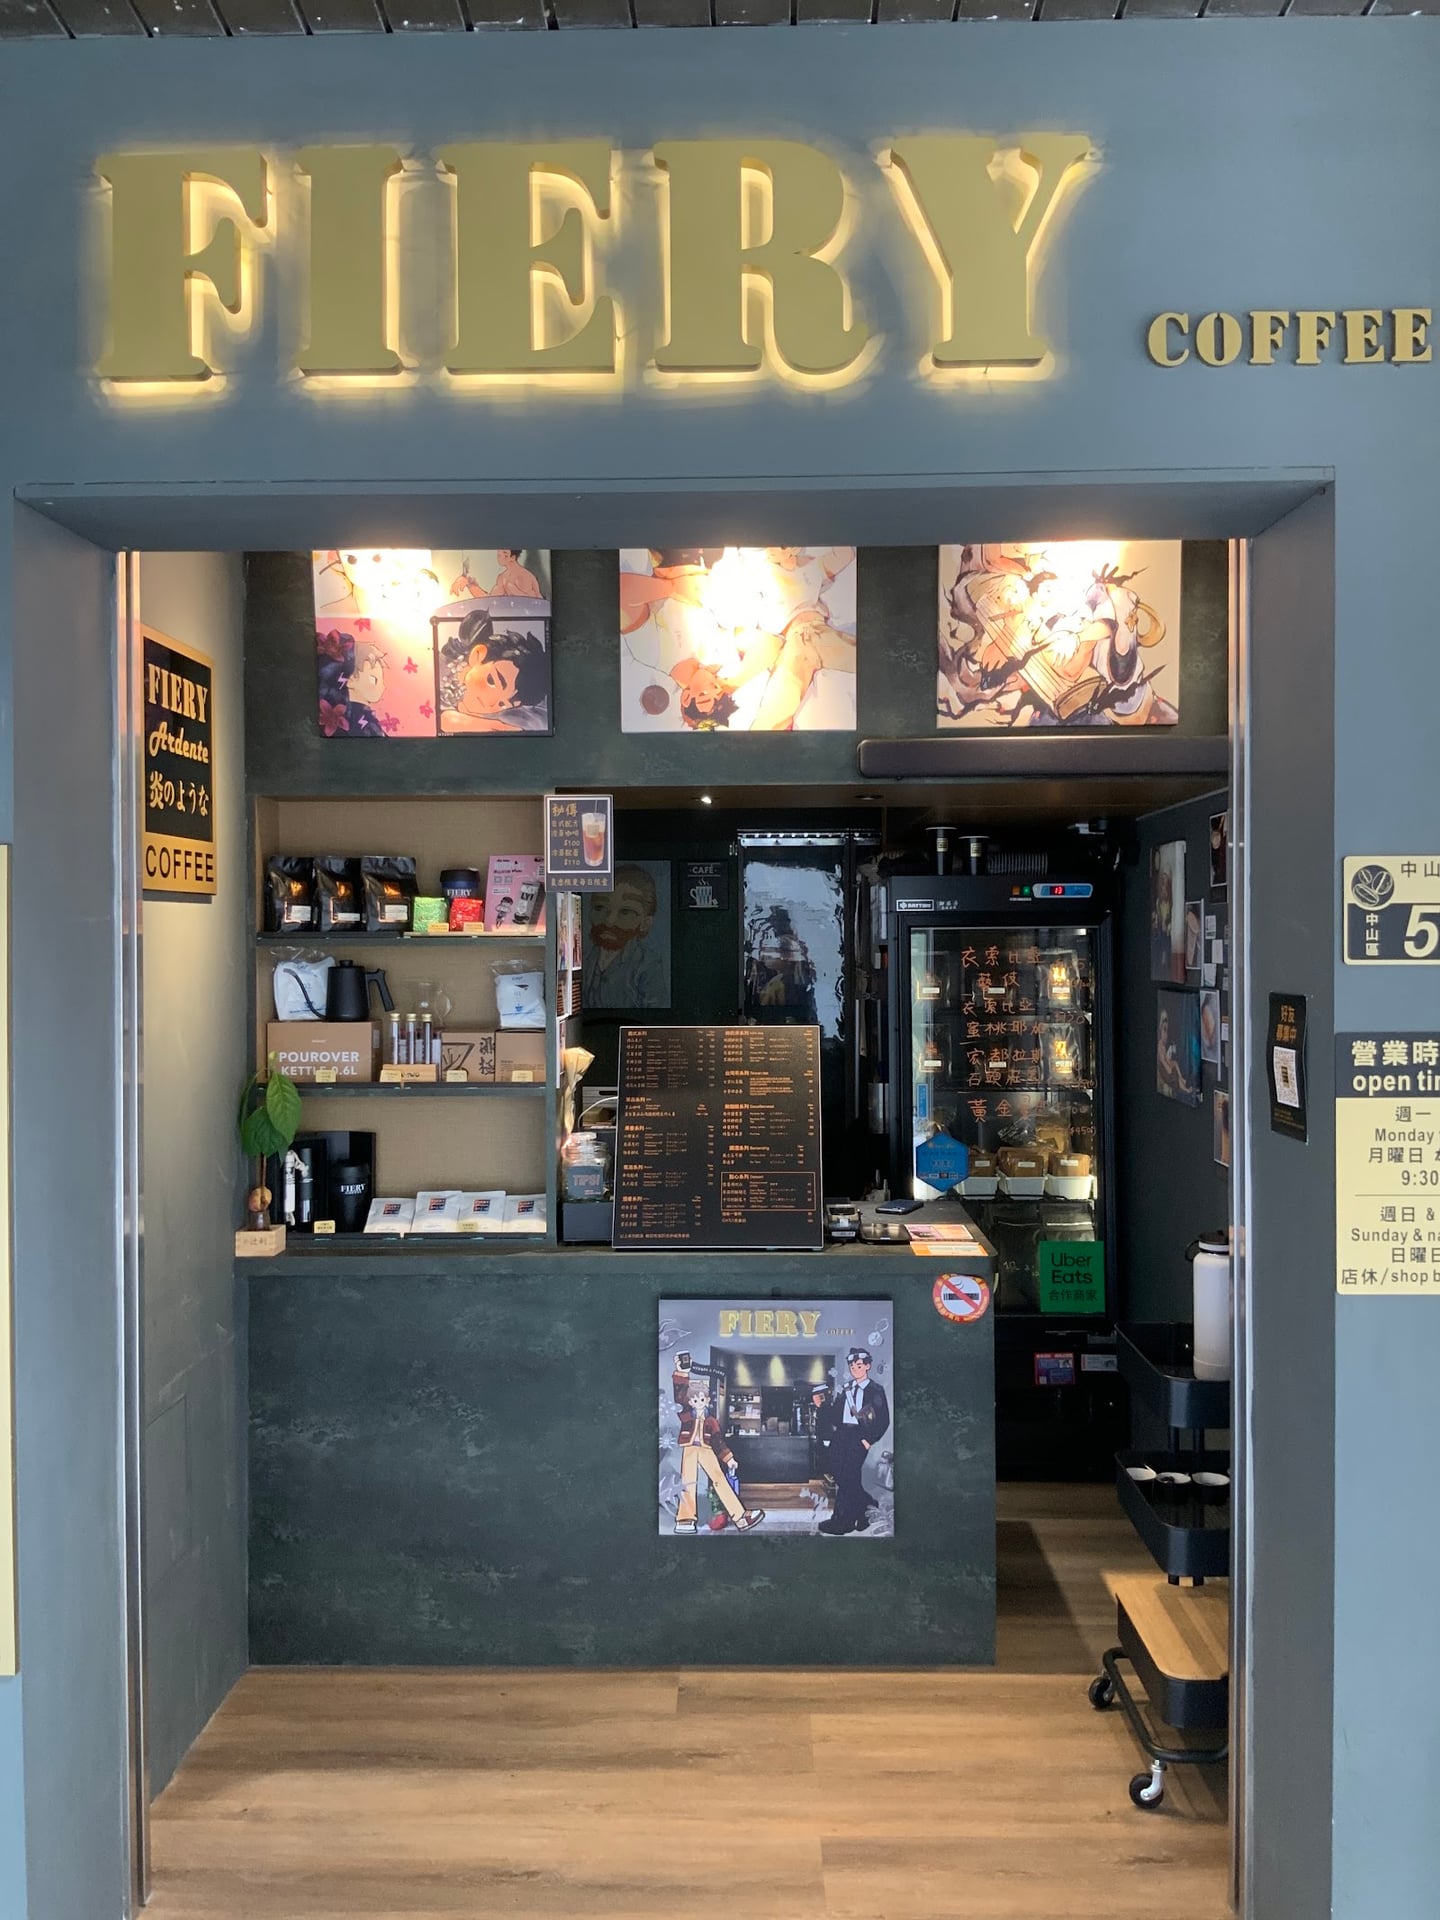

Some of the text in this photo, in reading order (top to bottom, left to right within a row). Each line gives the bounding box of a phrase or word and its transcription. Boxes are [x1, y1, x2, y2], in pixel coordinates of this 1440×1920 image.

[95, 134, 1092, 385] FIERY
[1147, 308, 1433, 367] COFFEE
[147, 663, 208, 724] FIERY
[149, 720, 210, 764] Ardente
[149, 770, 210, 818] 炎のような
[145, 844, 215, 884] COFFEE
[447, 888, 472, 897] FIERY
[1281, 1004, 1296, 1023] 好友
[279, 1051, 359, 1062] POUROVER
[1352, 1074, 1412, 1097] open
[1395, 1105, 1432, 1123] 週一
[1375, 1128, 1434, 1145] Monday
[1401, 1169, 1439, 1186] 9:30
[340, 1183, 366, 1193] FIERY
[1380, 1206, 1435, 1223] 週日 &
[1351, 1227, 1408, 1245] Sunday
[1413, 1227, 1423, 1242] &
[1051, 1252, 1093, 1268] Uber
[1051, 1269, 1094, 1285] Eats
[1047, 1288, 1098, 1302] 合作商家
[719, 1309, 822, 1338] FIERY
